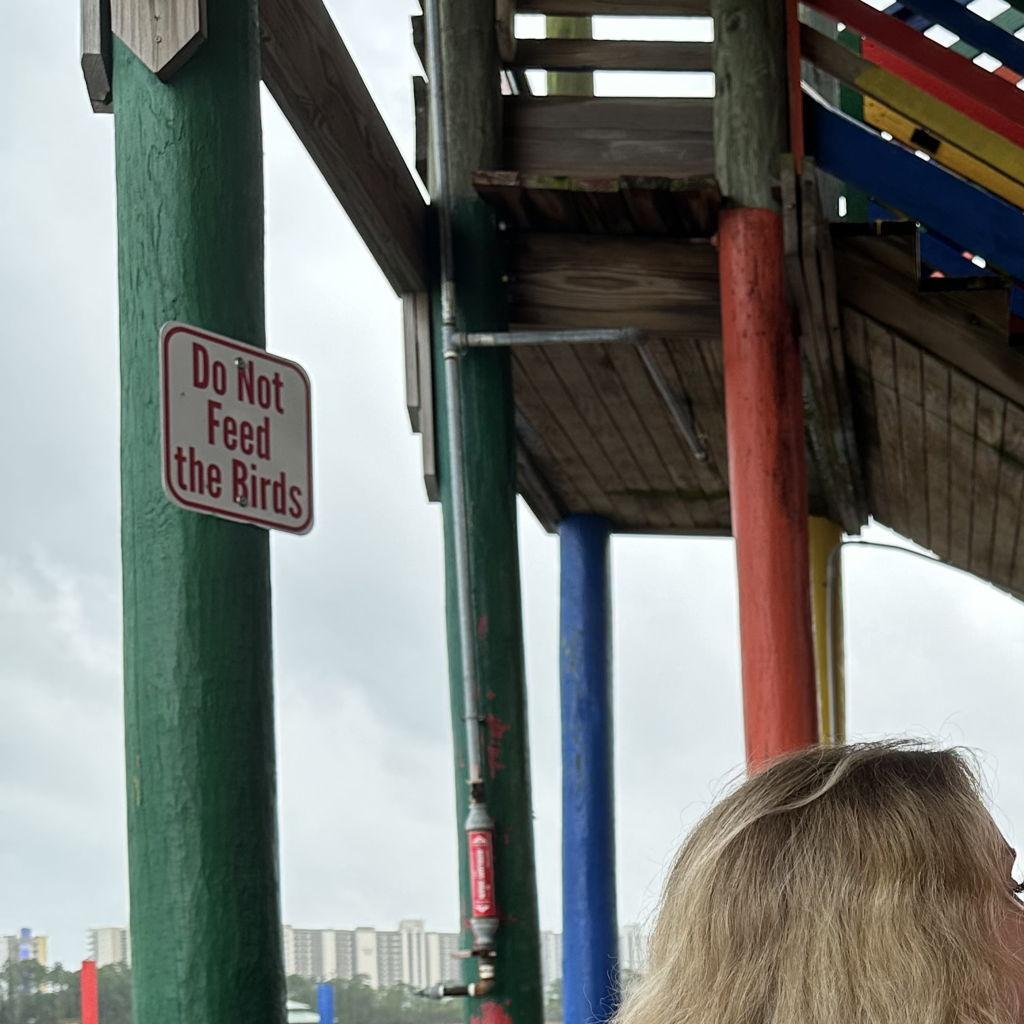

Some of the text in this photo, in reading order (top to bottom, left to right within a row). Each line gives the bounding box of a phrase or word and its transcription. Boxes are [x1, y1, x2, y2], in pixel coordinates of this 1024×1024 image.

[192, 342, 285, 414] Do Not
[207, 399, 271, 460] Feed
[174, 446, 303, 519] the Birds
